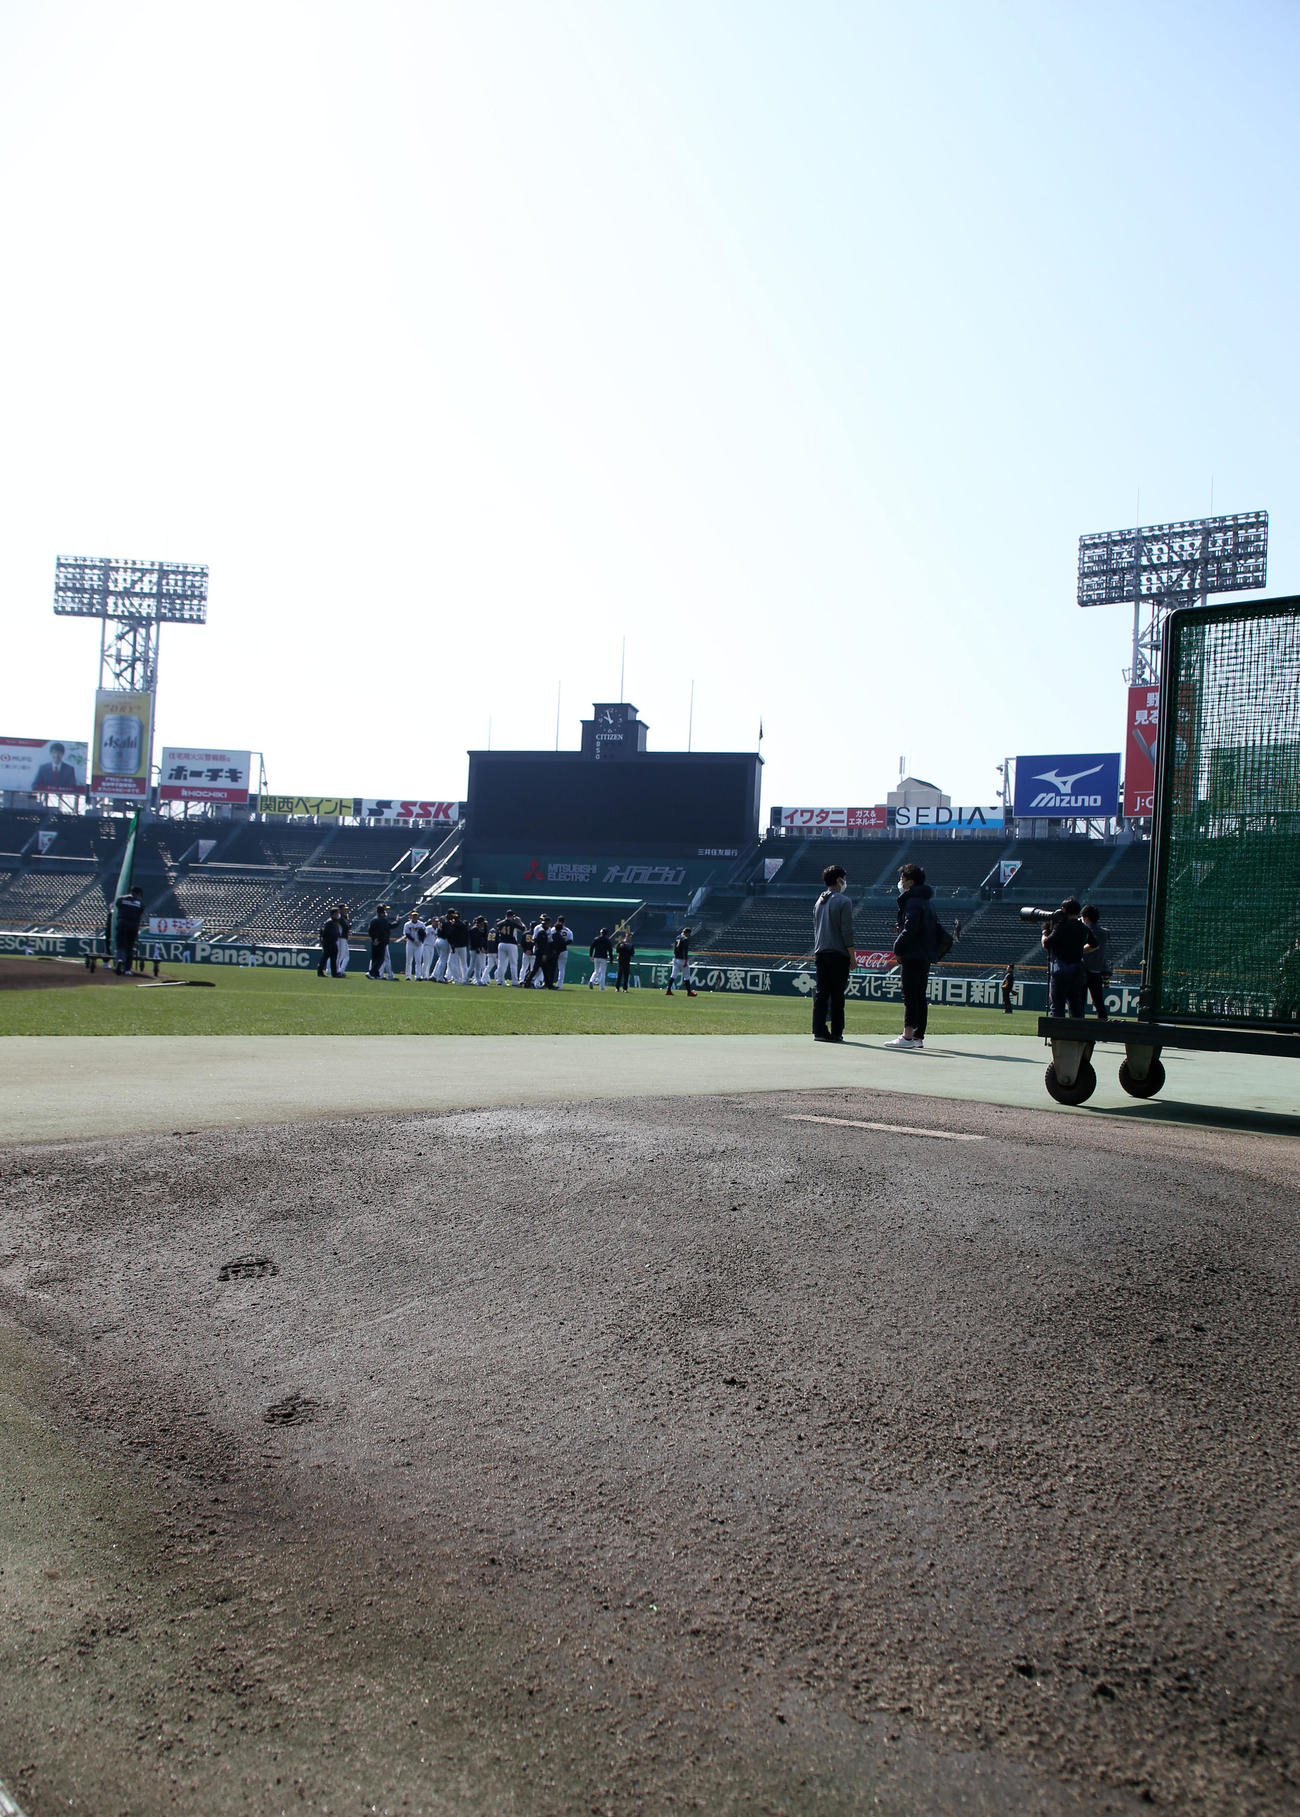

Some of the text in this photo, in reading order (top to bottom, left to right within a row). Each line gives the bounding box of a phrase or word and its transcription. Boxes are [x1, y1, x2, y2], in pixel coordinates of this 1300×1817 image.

[1134, 708, 1159, 726] 見る
[104, 735, 138, 750] Asahi
[595, 733, 624, 741] CITIZEN
[168, 765, 243, 783] ホーチキ
[259, 796, 352, 815] 関西ペイント
[396, 801, 456, 820] SSK
[784, 809, 846, 826] イワタニ
[848, 818, 884, 827] エネルギー
[547, 863, 597, 874] MITSUBISHI
[547, 872, 590, 882] ELECTRIC
[195, 943, 310, 967] Panasonic
